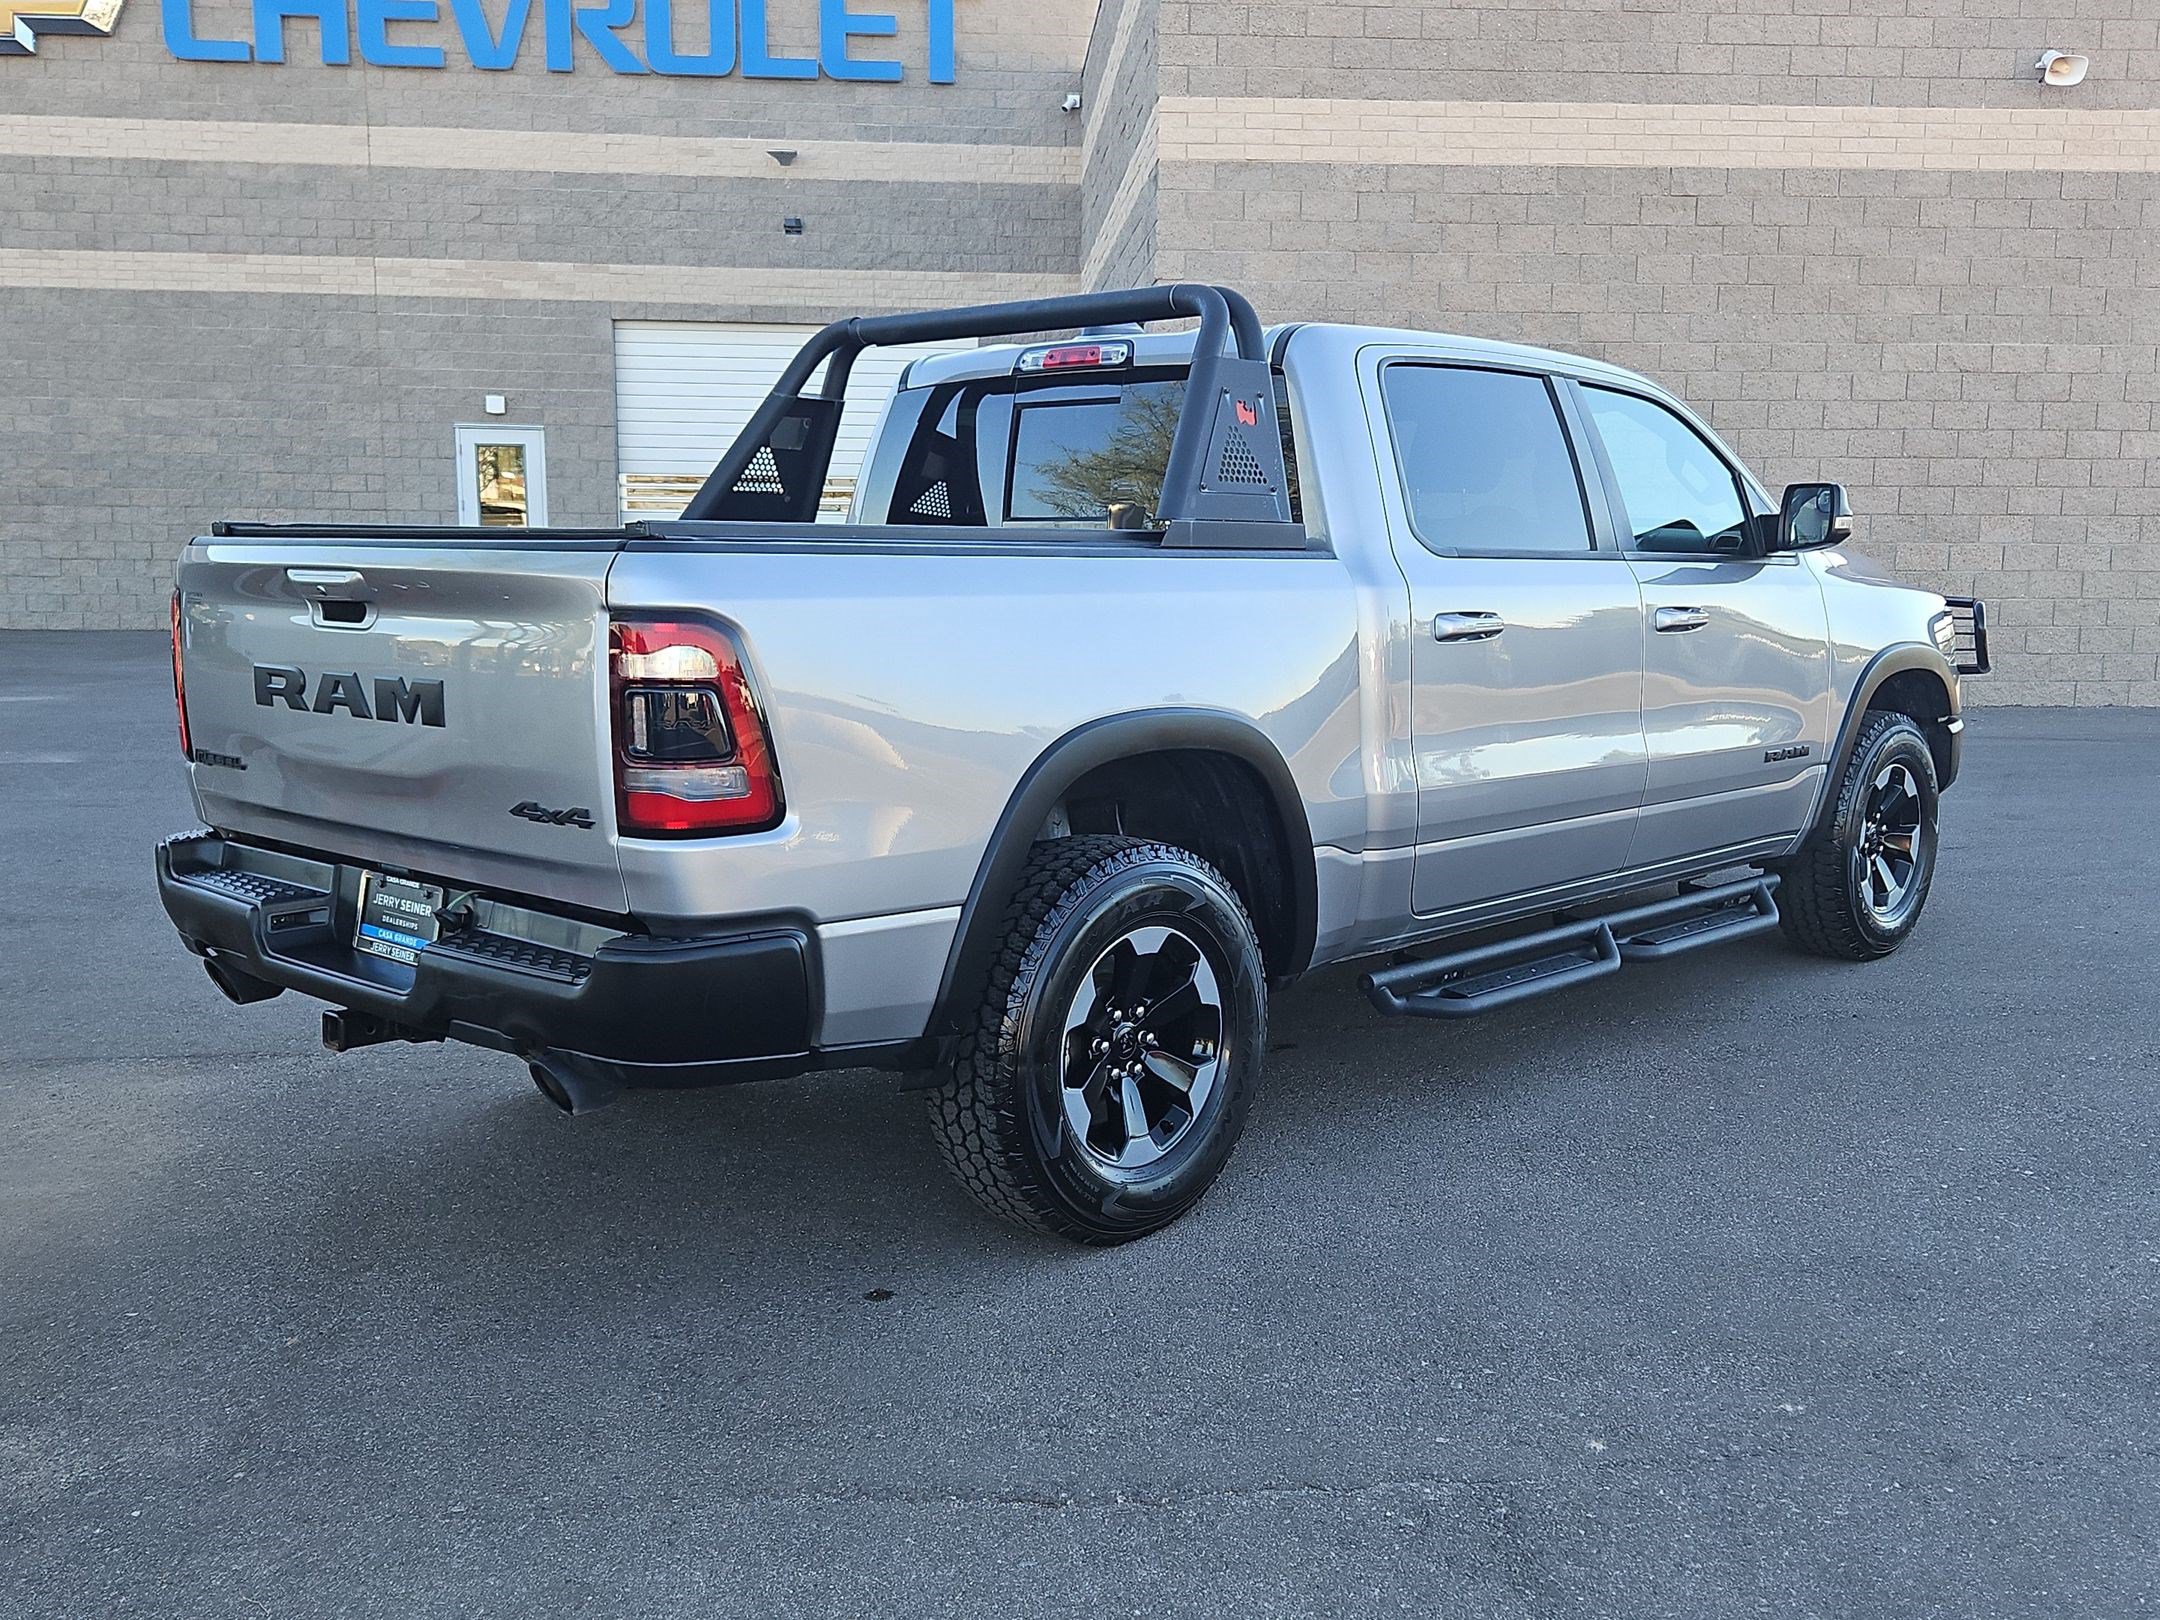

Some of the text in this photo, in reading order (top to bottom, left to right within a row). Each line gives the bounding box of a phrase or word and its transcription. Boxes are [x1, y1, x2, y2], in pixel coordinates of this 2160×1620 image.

[254, 662, 446, 728] RAM
[373, 893, 432, 917] JERRY SEINER
[382, 915, 418, 930] DEALERSHIPS
[378, 930, 417, 947] CASA GRANDE
[371, 942, 415, 962] JERRY SEINER
